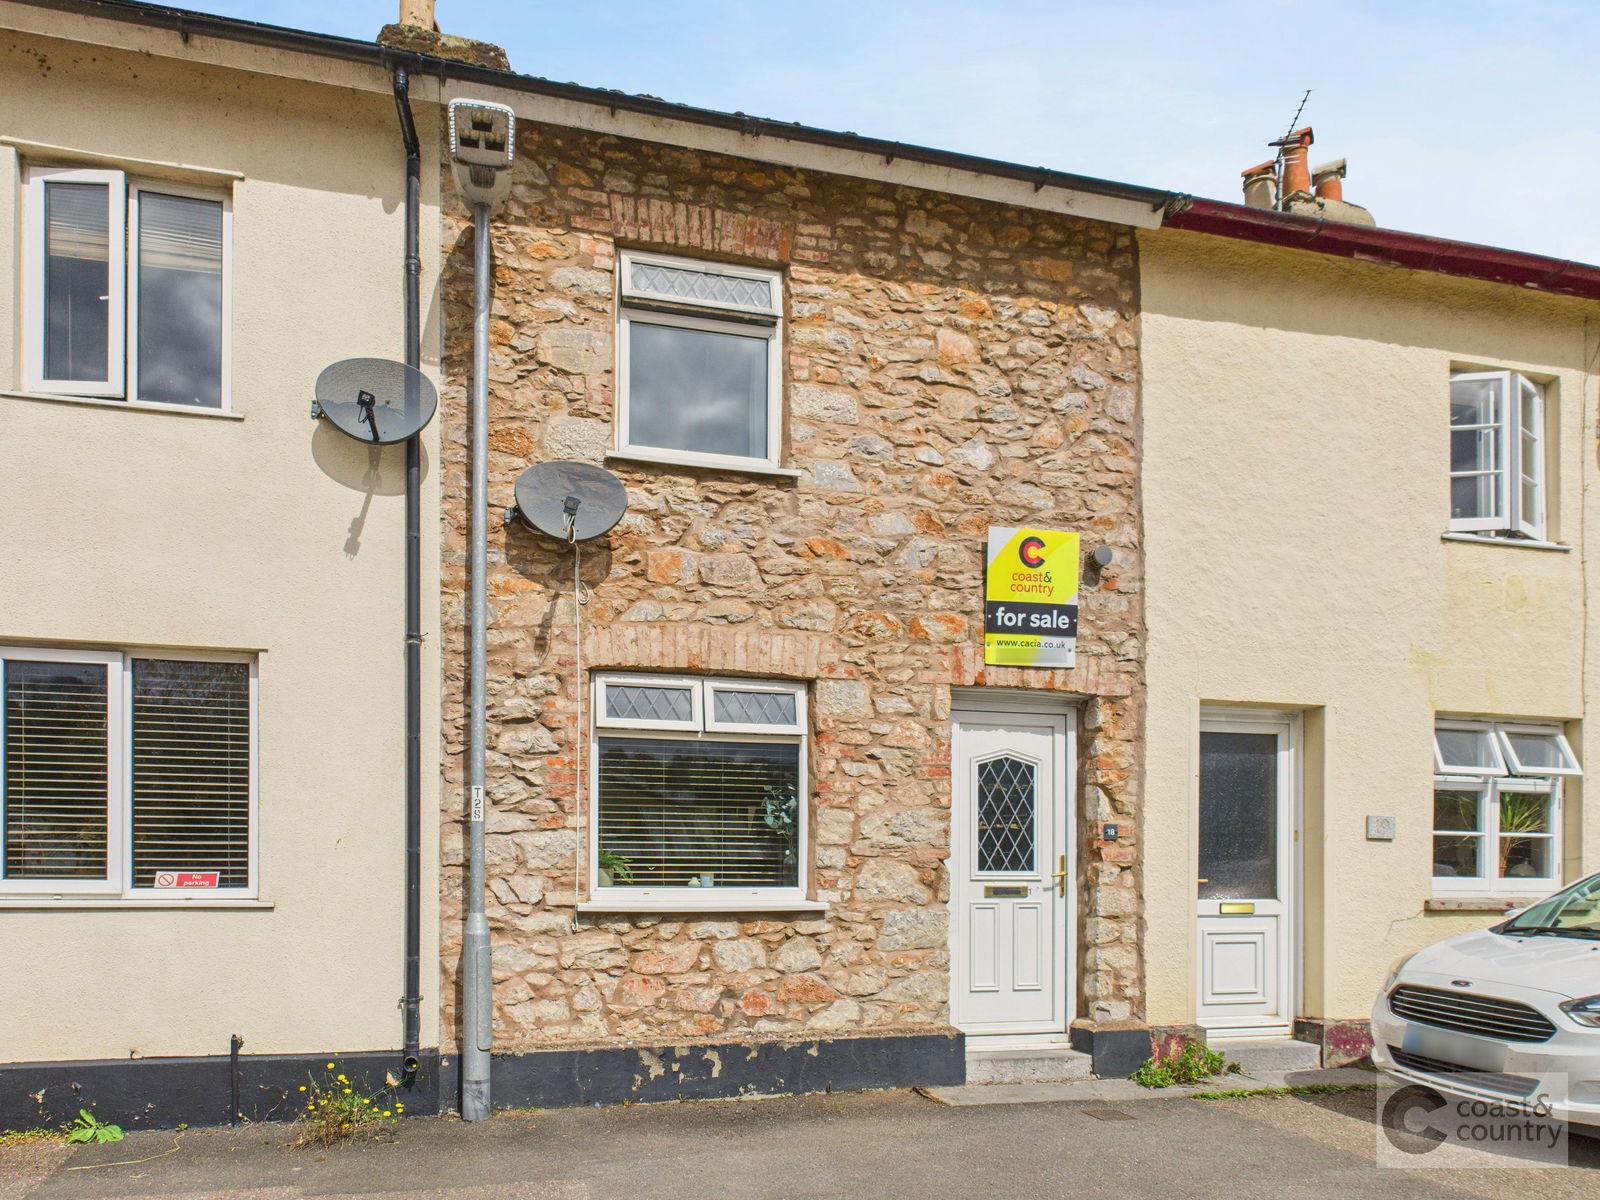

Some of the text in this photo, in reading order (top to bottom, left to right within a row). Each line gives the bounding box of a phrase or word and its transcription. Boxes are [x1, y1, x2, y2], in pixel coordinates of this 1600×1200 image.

[1012, 571, 1052, 583] coast&
[1010, 583, 1054, 597] country
[995, 606, 1070, 629] for sale
[996, 639, 1066, 649] www.cacia.co.uk
[1107, 828, 1115, 836] 18
